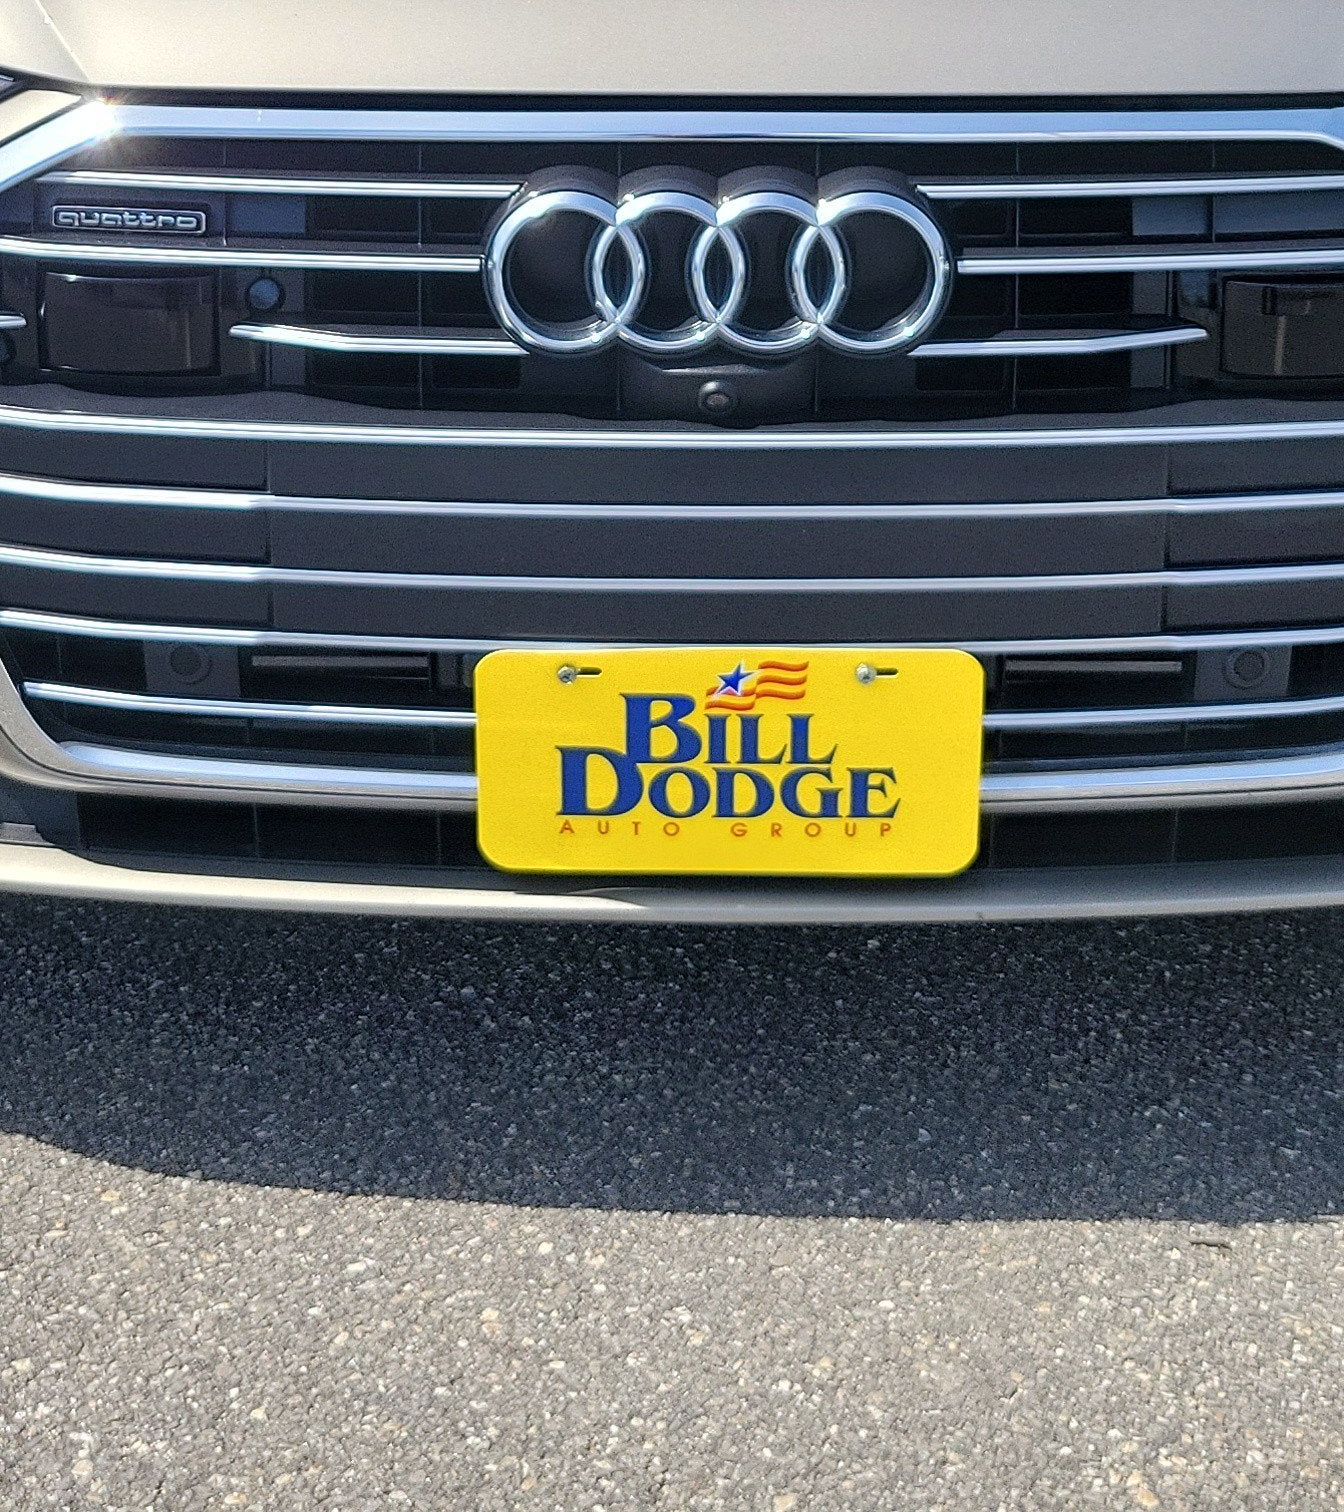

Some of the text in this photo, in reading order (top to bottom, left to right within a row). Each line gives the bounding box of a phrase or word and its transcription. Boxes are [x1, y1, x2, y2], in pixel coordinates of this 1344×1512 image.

[58, 211, 198, 228] quattro
[620, 693, 837, 764] BILL
[555, 745, 901, 819] DODGE
[559, 819, 892, 838] AUTO GROUP
